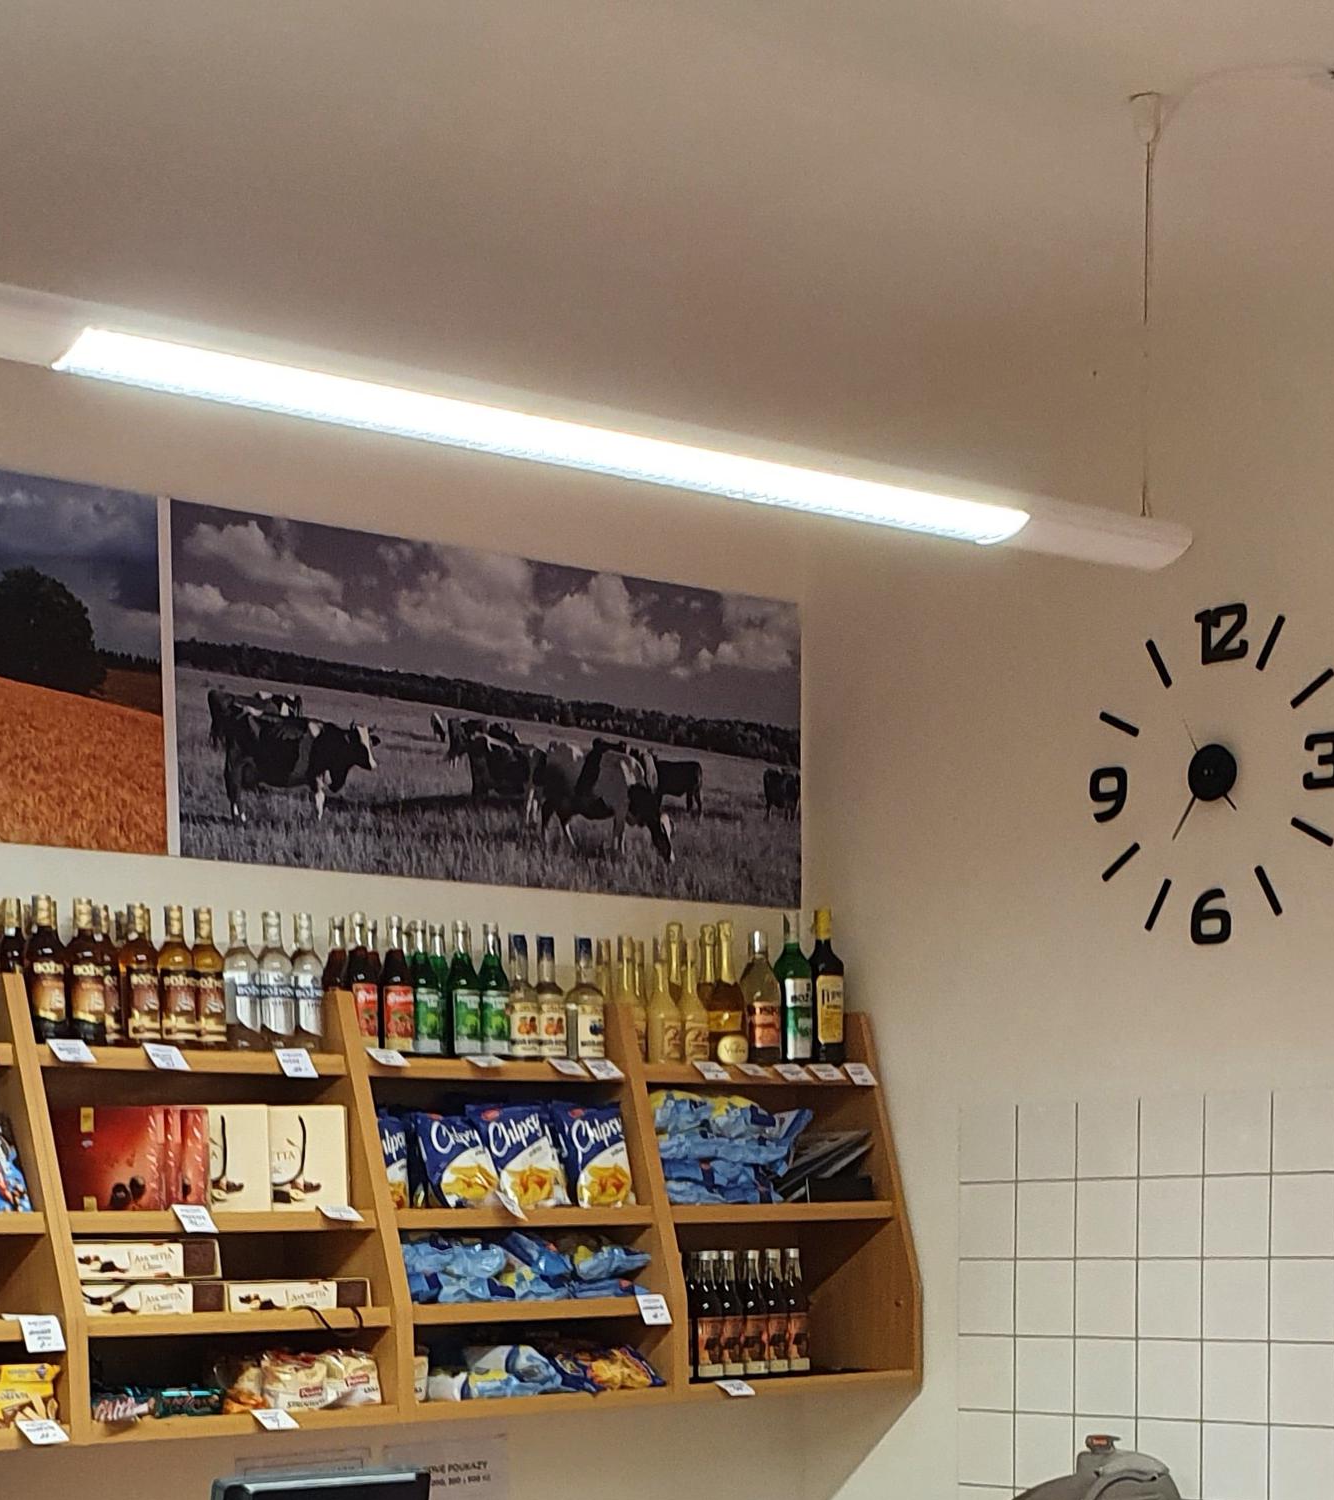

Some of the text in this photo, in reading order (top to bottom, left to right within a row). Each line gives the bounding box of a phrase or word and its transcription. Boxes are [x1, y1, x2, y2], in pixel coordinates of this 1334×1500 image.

[1194, 602, 1248, 665] 12
[1089, 766, 1128, 823] 9
[1190, 888, 1232, 945] 6
[488, 1112, 543, 1157] Chipsy
[571, 1116, 624, 1153] Chipsy
